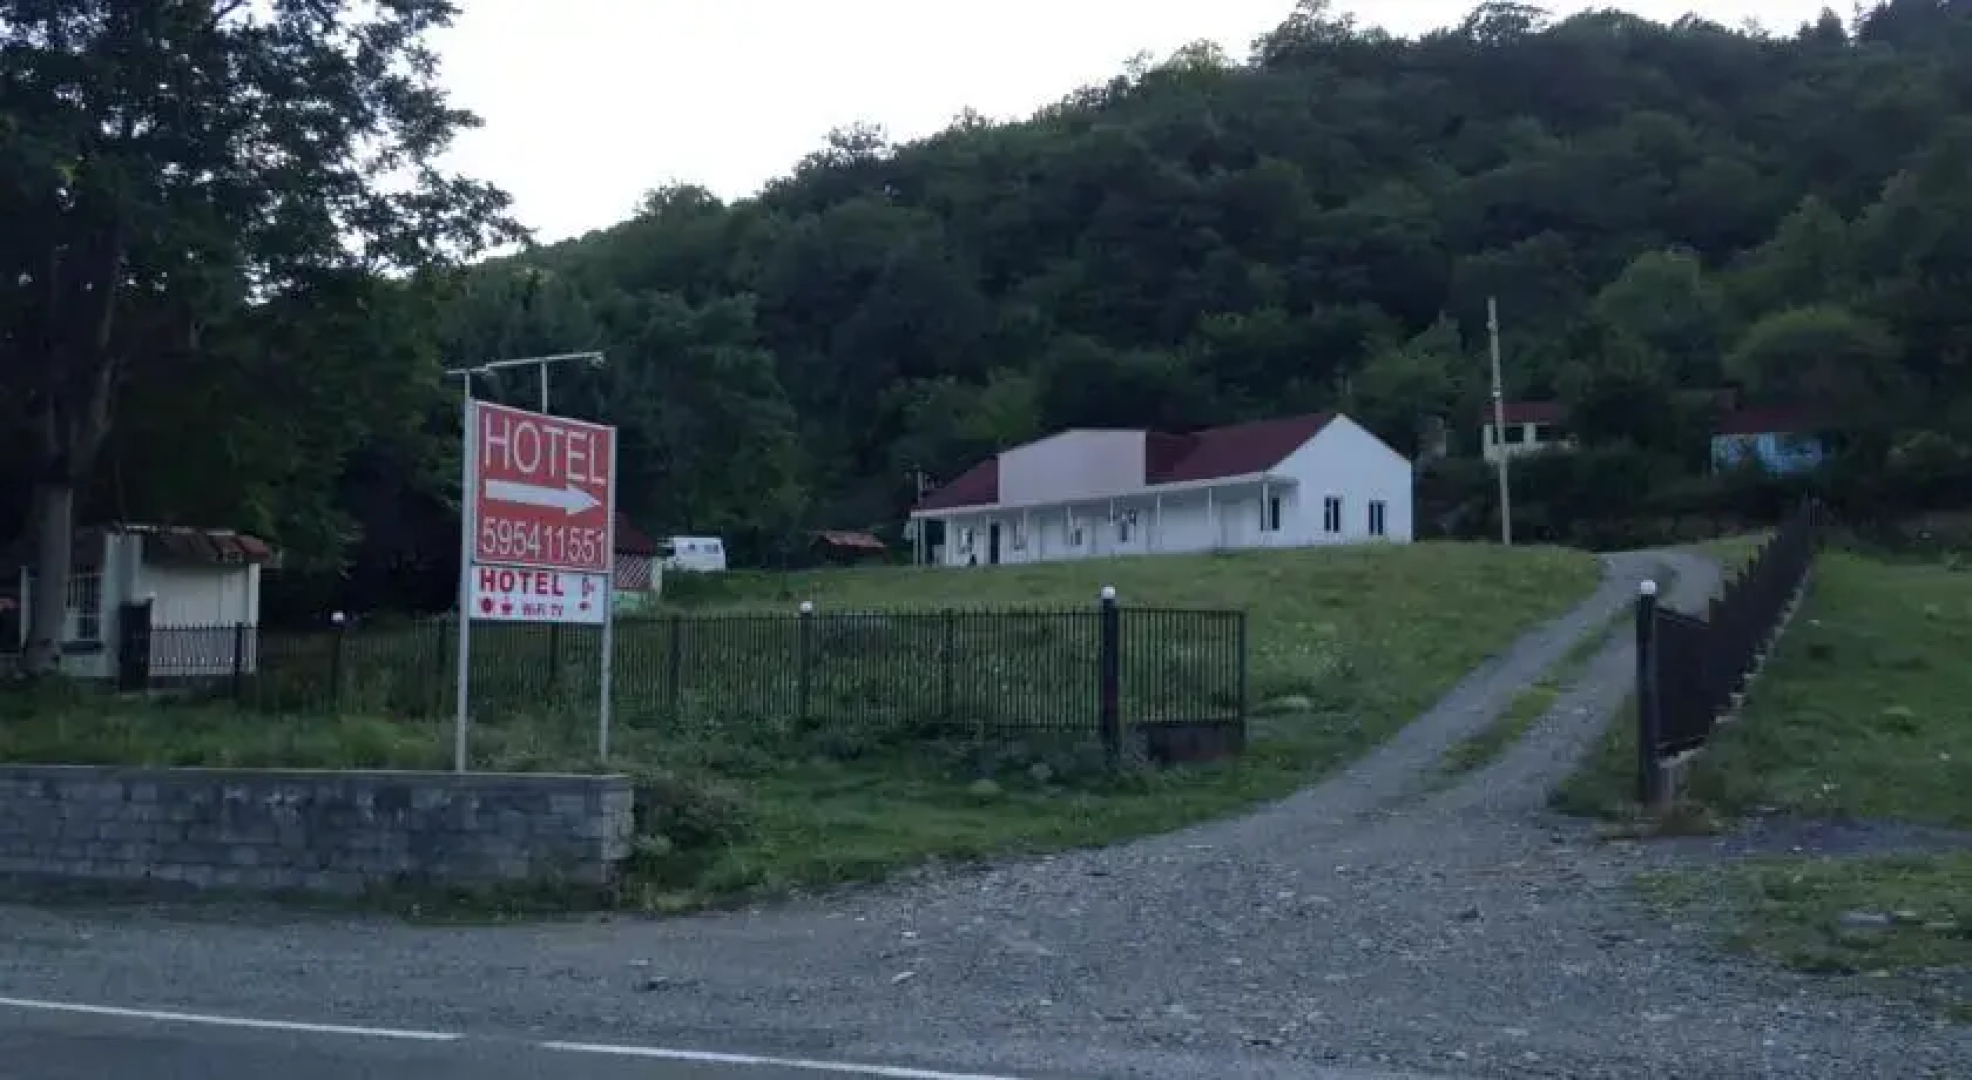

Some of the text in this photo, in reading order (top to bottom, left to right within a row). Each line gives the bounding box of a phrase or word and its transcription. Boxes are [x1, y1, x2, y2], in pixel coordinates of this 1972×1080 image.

[486, 413, 606, 485] HOTEL
[483, 516, 604, 566] 595411551
[480, 568, 564, 597] HOTEL
